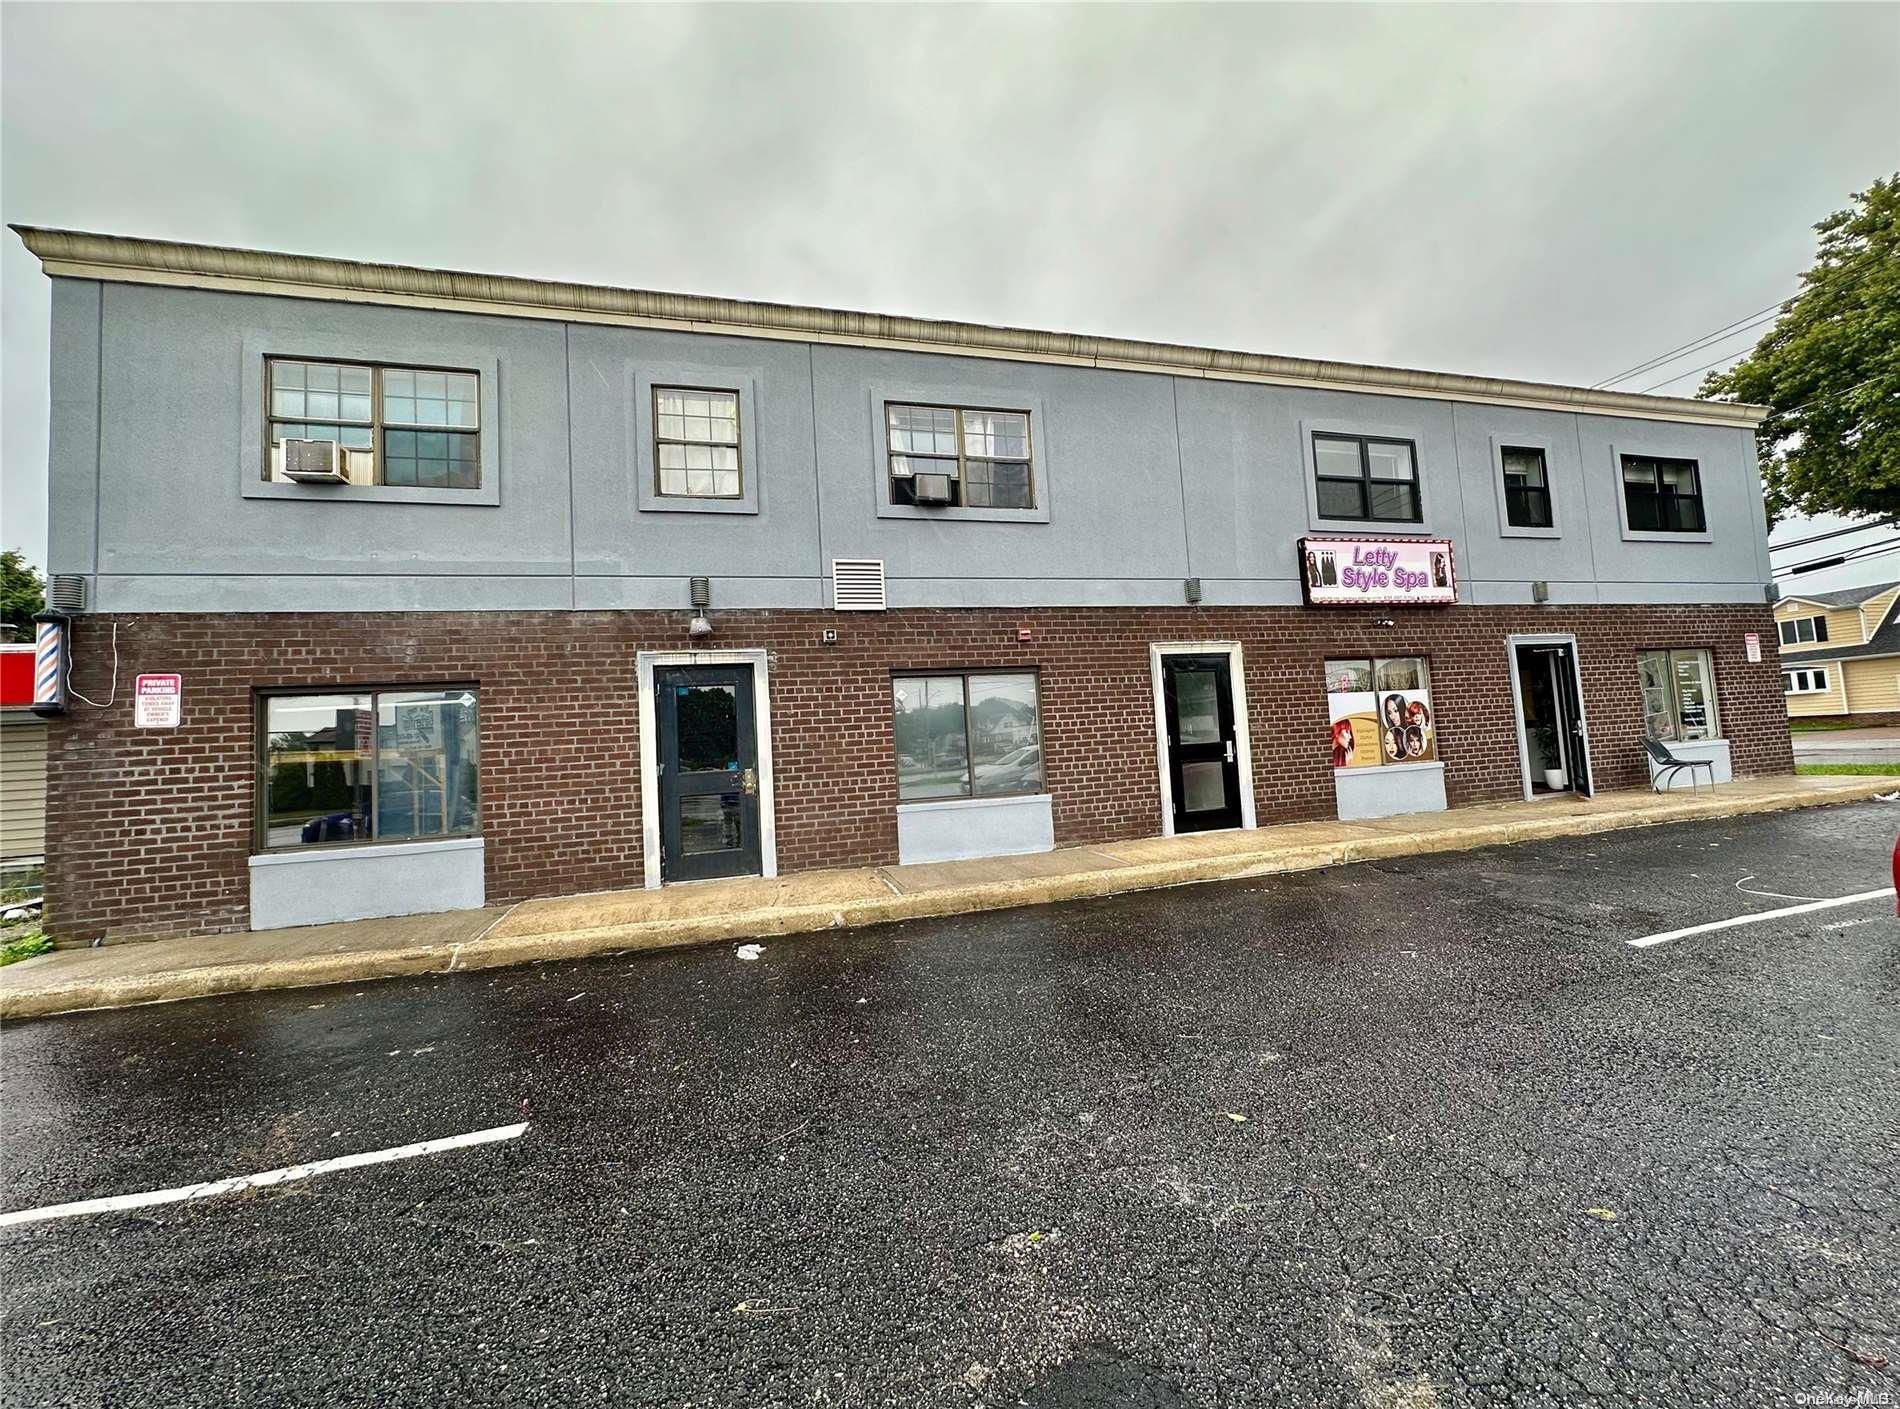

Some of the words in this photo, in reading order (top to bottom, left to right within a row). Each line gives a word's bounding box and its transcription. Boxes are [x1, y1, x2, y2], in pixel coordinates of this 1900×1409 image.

[1352, 544, 1398, 572] Letty
[1341, 566, 1390, 592] Style
[1393, 567, 1429, 592] Spa
